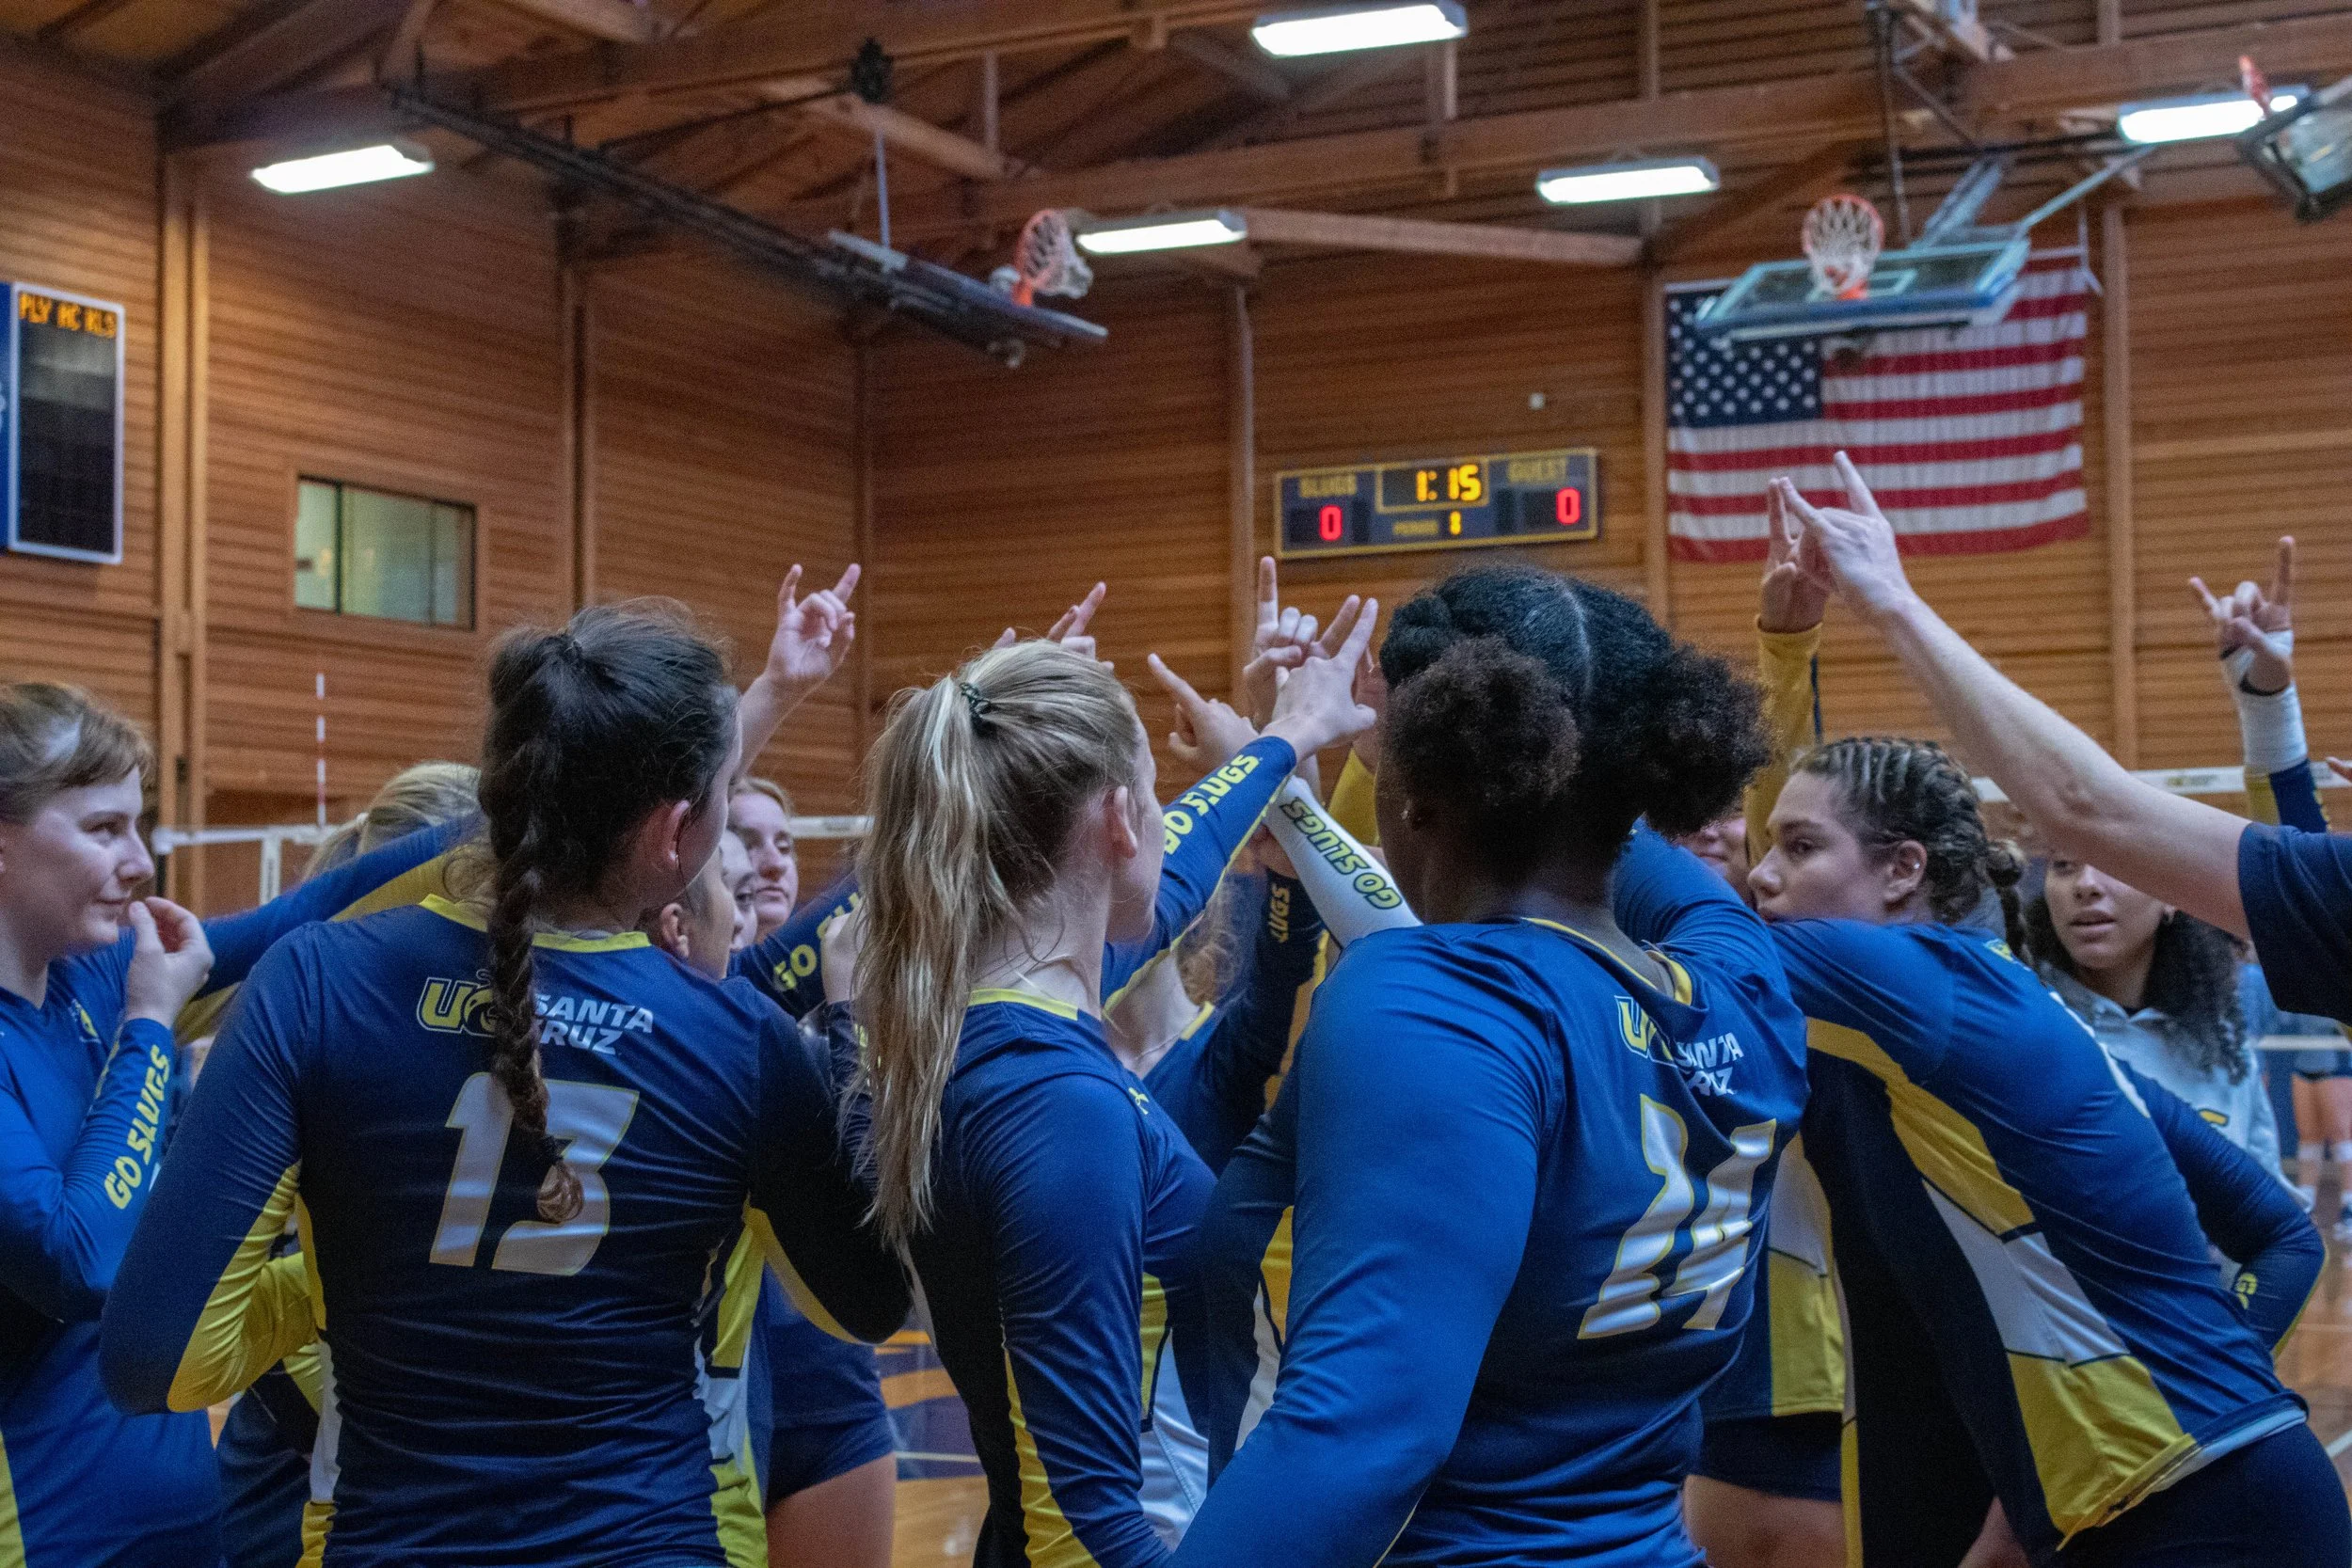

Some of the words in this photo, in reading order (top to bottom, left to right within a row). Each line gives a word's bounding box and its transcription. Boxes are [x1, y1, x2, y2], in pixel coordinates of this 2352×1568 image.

[1416, 464, 1481, 502] 1:15
[1319, 504, 1343, 541] 0
[1449, 511, 1462, 535] 1
[1555, 486, 1581, 525] 0
[1180, 754, 1260, 816] SUGS
[1279, 797, 1371, 876] SLUGS
[1353, 871, 1403, 910] GO
[534, 992, 654, 1033] SANTA
[532, 1018, 623, 1055] RUZ
[104, 1155, 142, 1210] GO
[126, 1044, 170, 1165] SLUGS
[429, 1071, 640, 1276] 13
